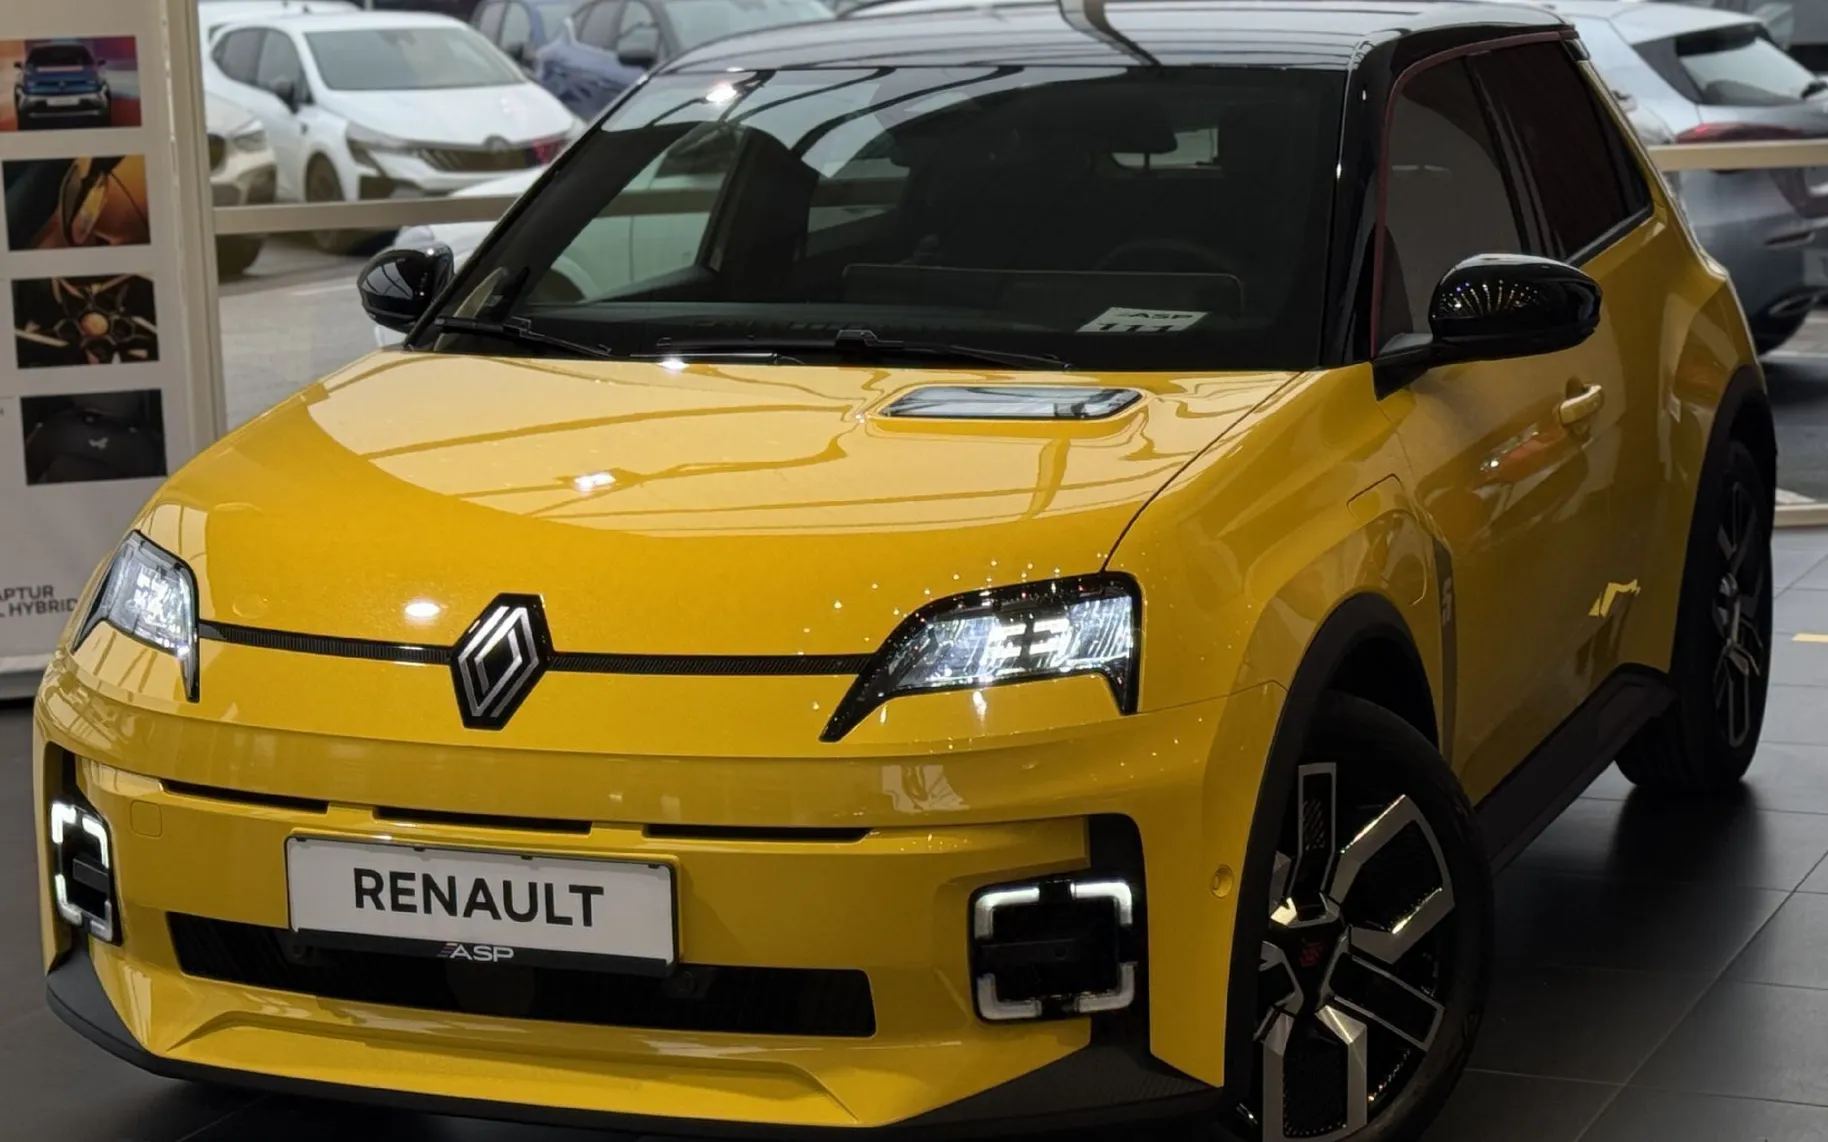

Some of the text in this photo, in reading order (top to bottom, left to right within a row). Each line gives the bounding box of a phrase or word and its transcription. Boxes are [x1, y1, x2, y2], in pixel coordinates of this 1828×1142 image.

[0, 585, 54, 601] PTUR
[8, 598, 78, 617] HYBRID
[353, 867, 604, 927] RENAULT
[449, 943, 515, 962] ASP
